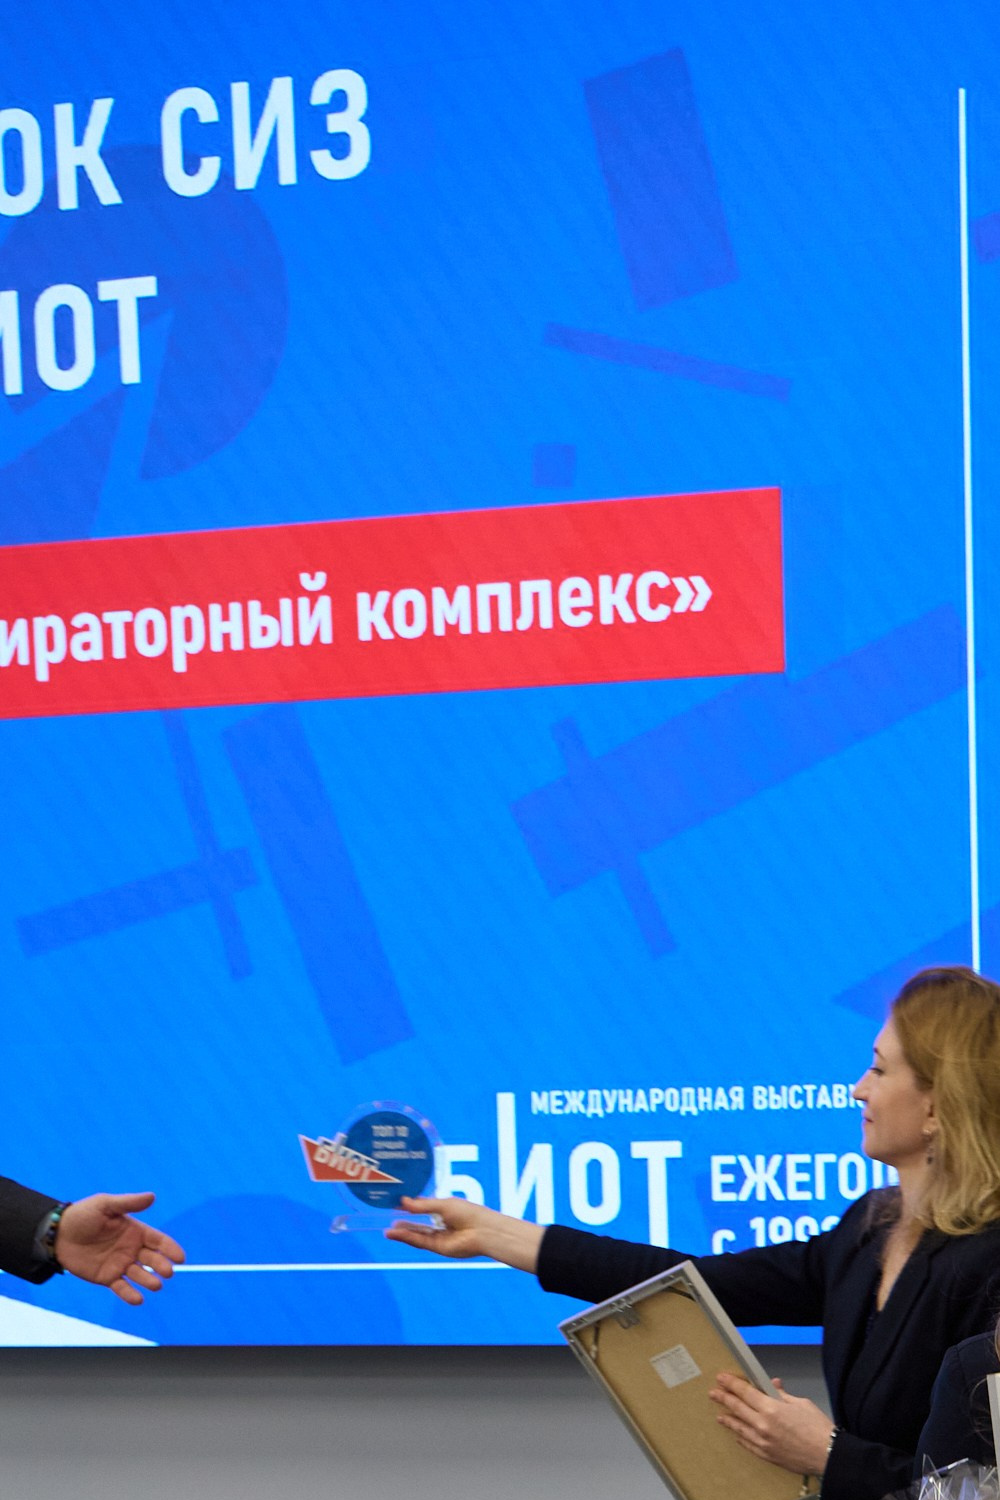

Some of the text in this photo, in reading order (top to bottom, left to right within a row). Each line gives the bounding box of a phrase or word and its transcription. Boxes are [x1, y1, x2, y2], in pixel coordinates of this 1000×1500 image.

[160, 68, 371, 197] СИЗ
[0, 571, 713, 682] ираторный комплекс»
[530, 1085, 745, 1118] МЕЖДУНАРОДНАЯ
